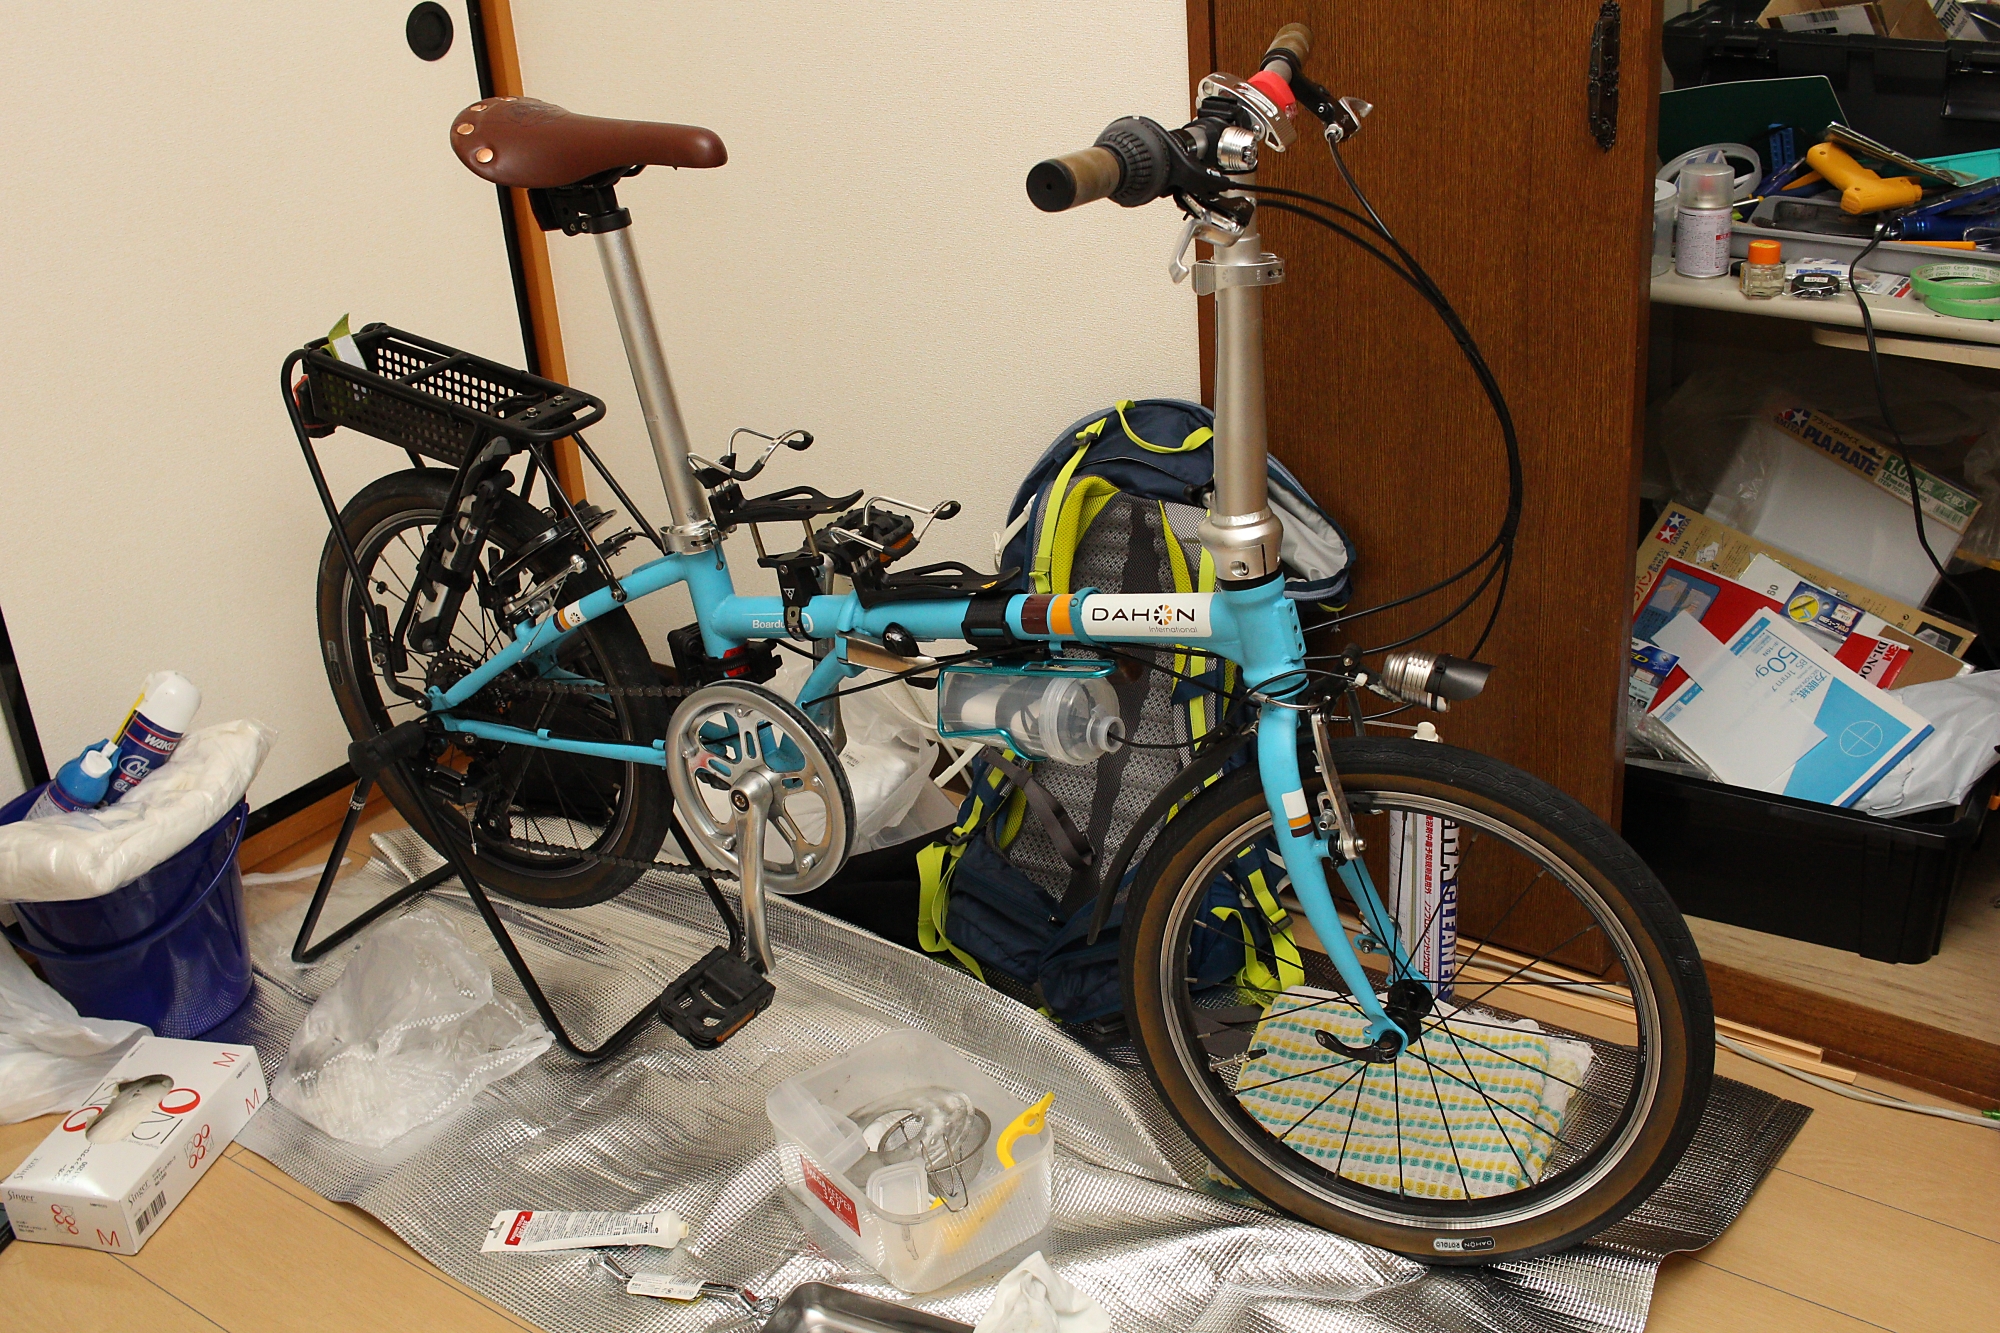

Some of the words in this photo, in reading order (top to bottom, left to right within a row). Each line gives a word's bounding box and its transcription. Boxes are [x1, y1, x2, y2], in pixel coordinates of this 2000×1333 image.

[1803, 425, 1832, 453] PLA
[1830, 440, 1880, 478] PLATE
[1670, 518, 1692, 546] TAMIYA
[1092, 605, 1195, 625] DAHON
[1882, 643, 1899, 662] 3M
[1796, 671, 1827, 700] 方眼紙
[1440, 884, 1458, 996] CLEANER
[213, 1052, 240, 1068] M
[245, 1088, 260, 1115] M
[7, 1190, 35, 1202] Singer
[127, 1180, 150, 1209] Singer
[96, 1228, 120, 1247] M
